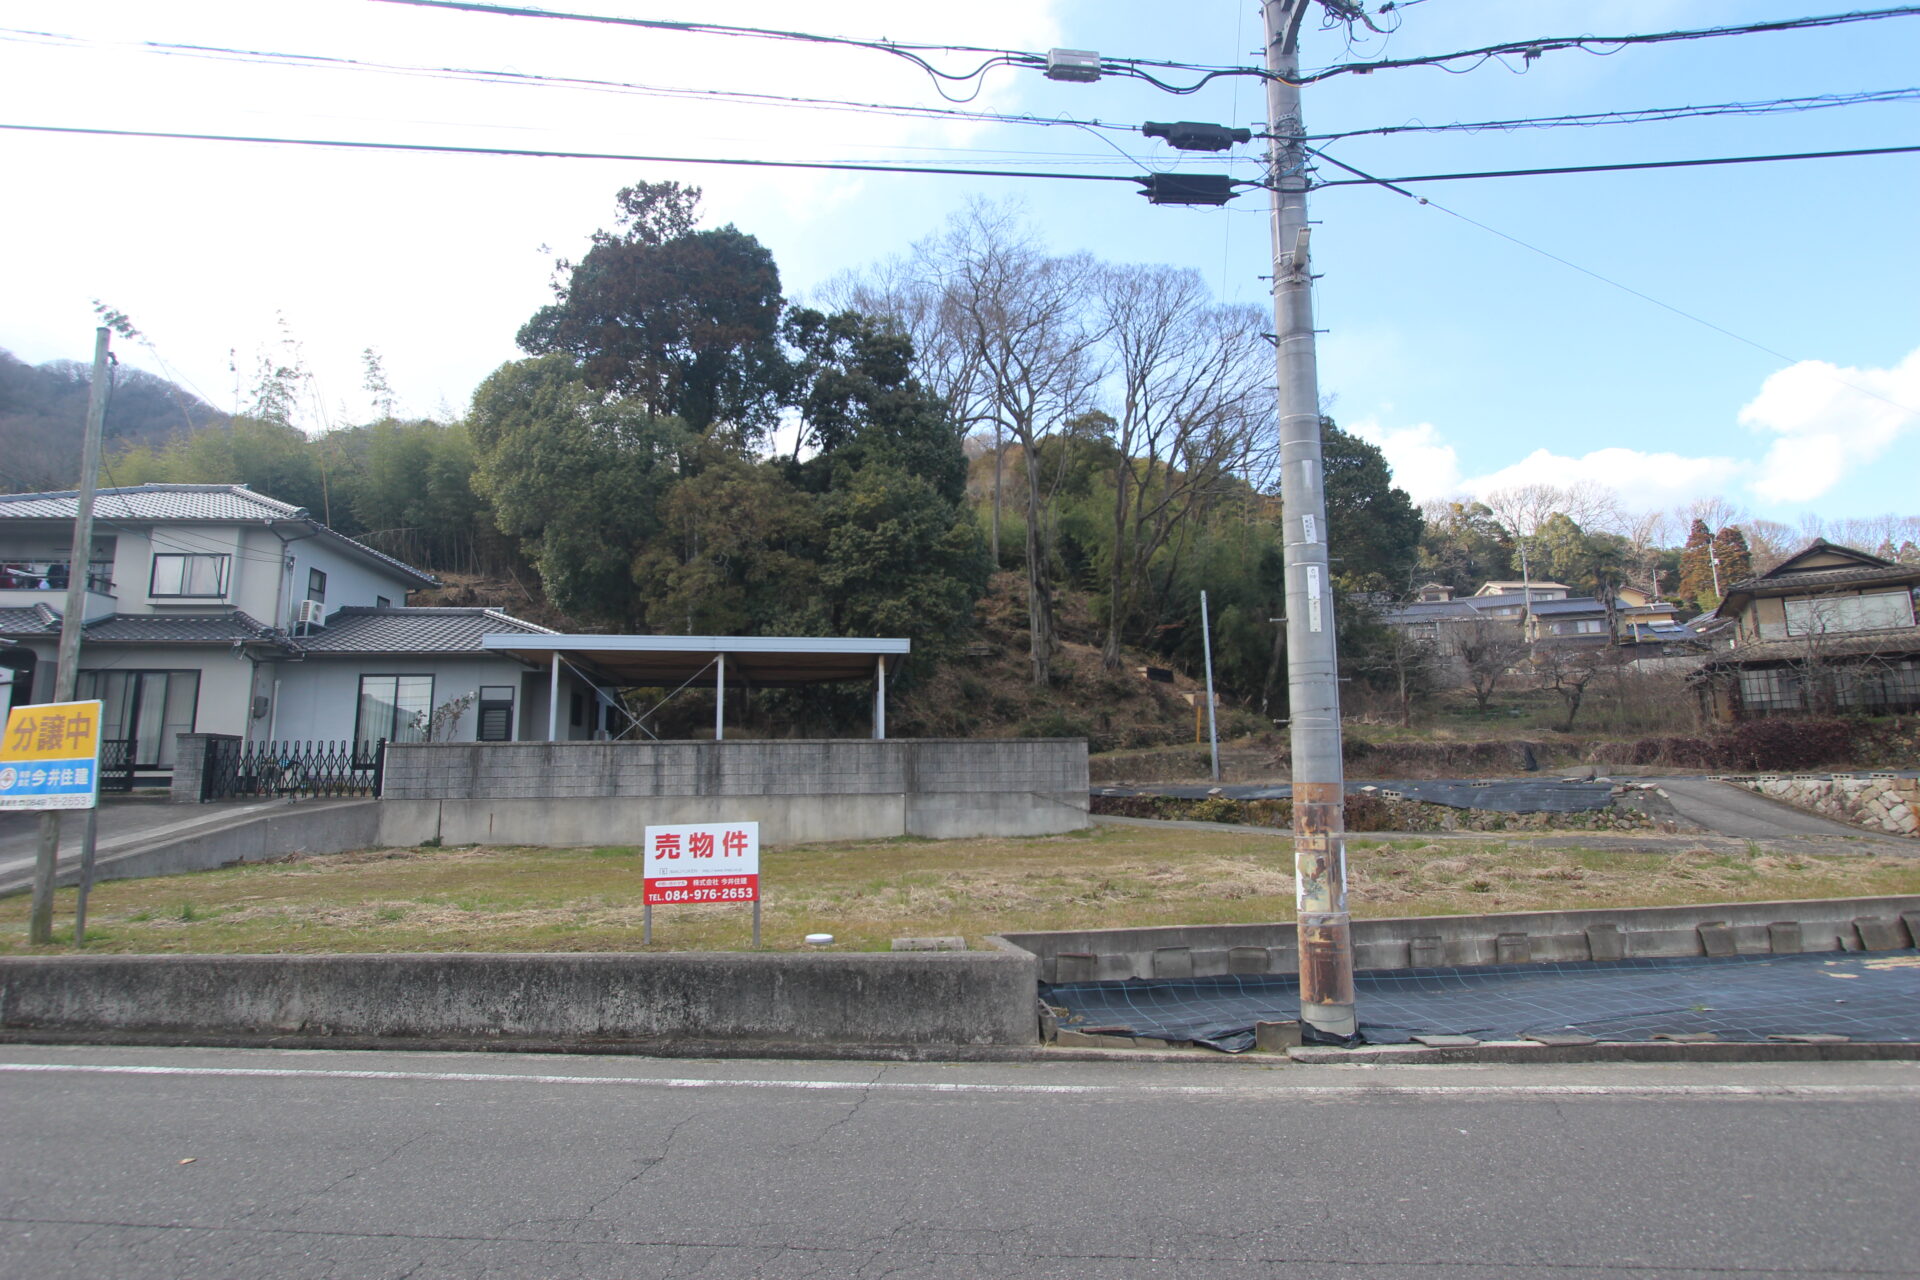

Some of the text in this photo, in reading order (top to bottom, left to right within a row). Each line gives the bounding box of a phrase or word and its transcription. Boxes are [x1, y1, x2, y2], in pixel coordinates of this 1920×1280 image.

[12, 712, 91, 751] 分譲中
[655, 831, 748, 860] 売物件
[693, 879, 719, 887] 株式会社
[665, 888, 753, 901] 084-976-2653
